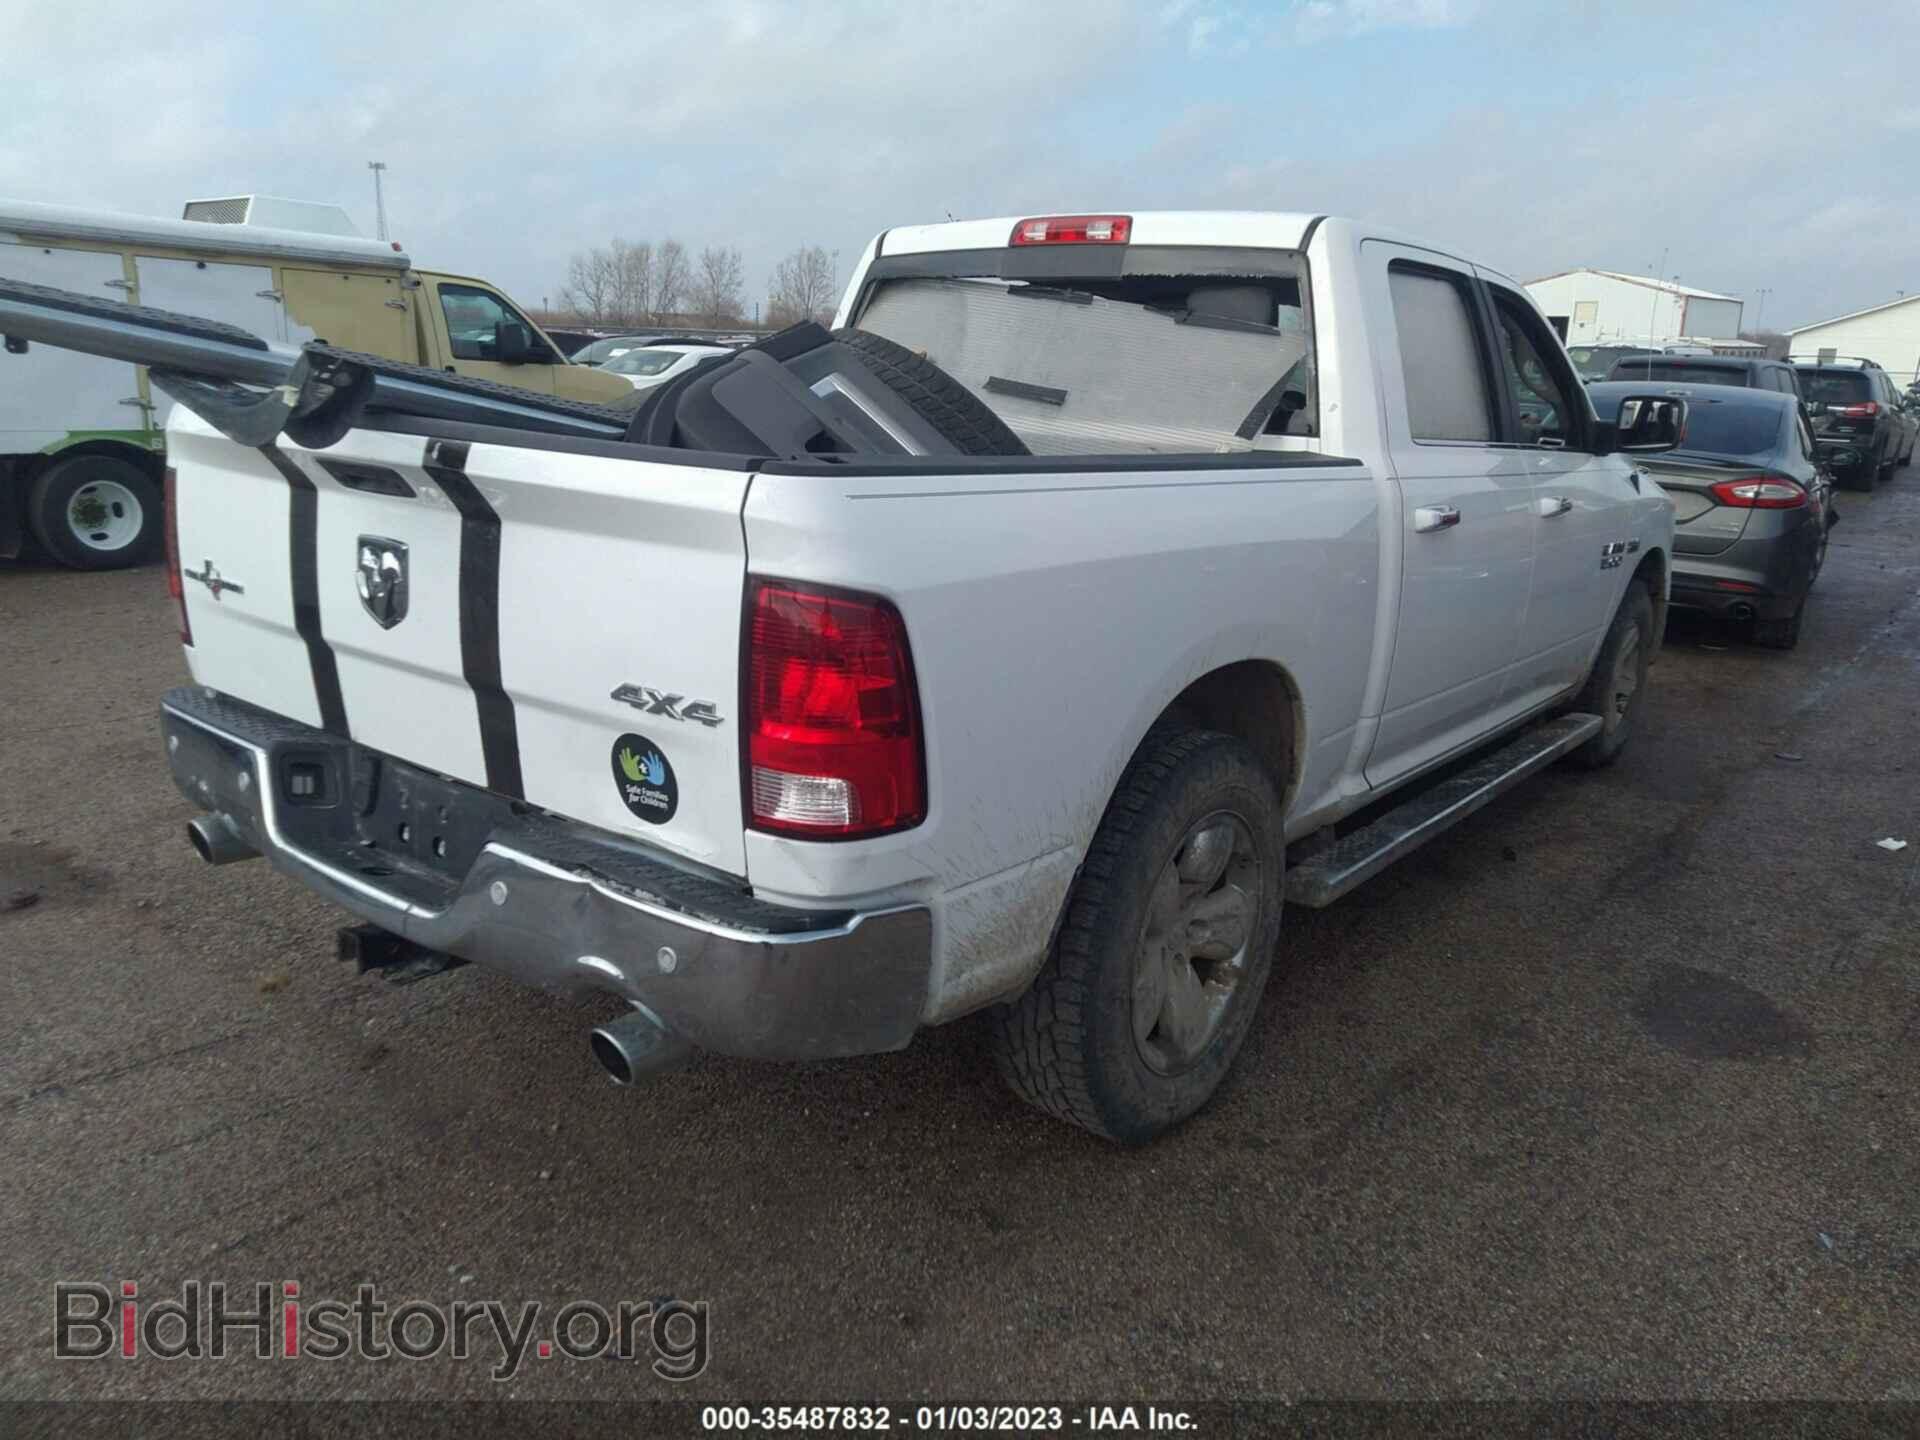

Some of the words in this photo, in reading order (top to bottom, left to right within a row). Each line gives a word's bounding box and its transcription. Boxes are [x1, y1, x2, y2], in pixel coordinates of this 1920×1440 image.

[625, 784, 641, 795] Safe
[628, 793, 640, 804] for
[640, 795, 668, 809] Children
